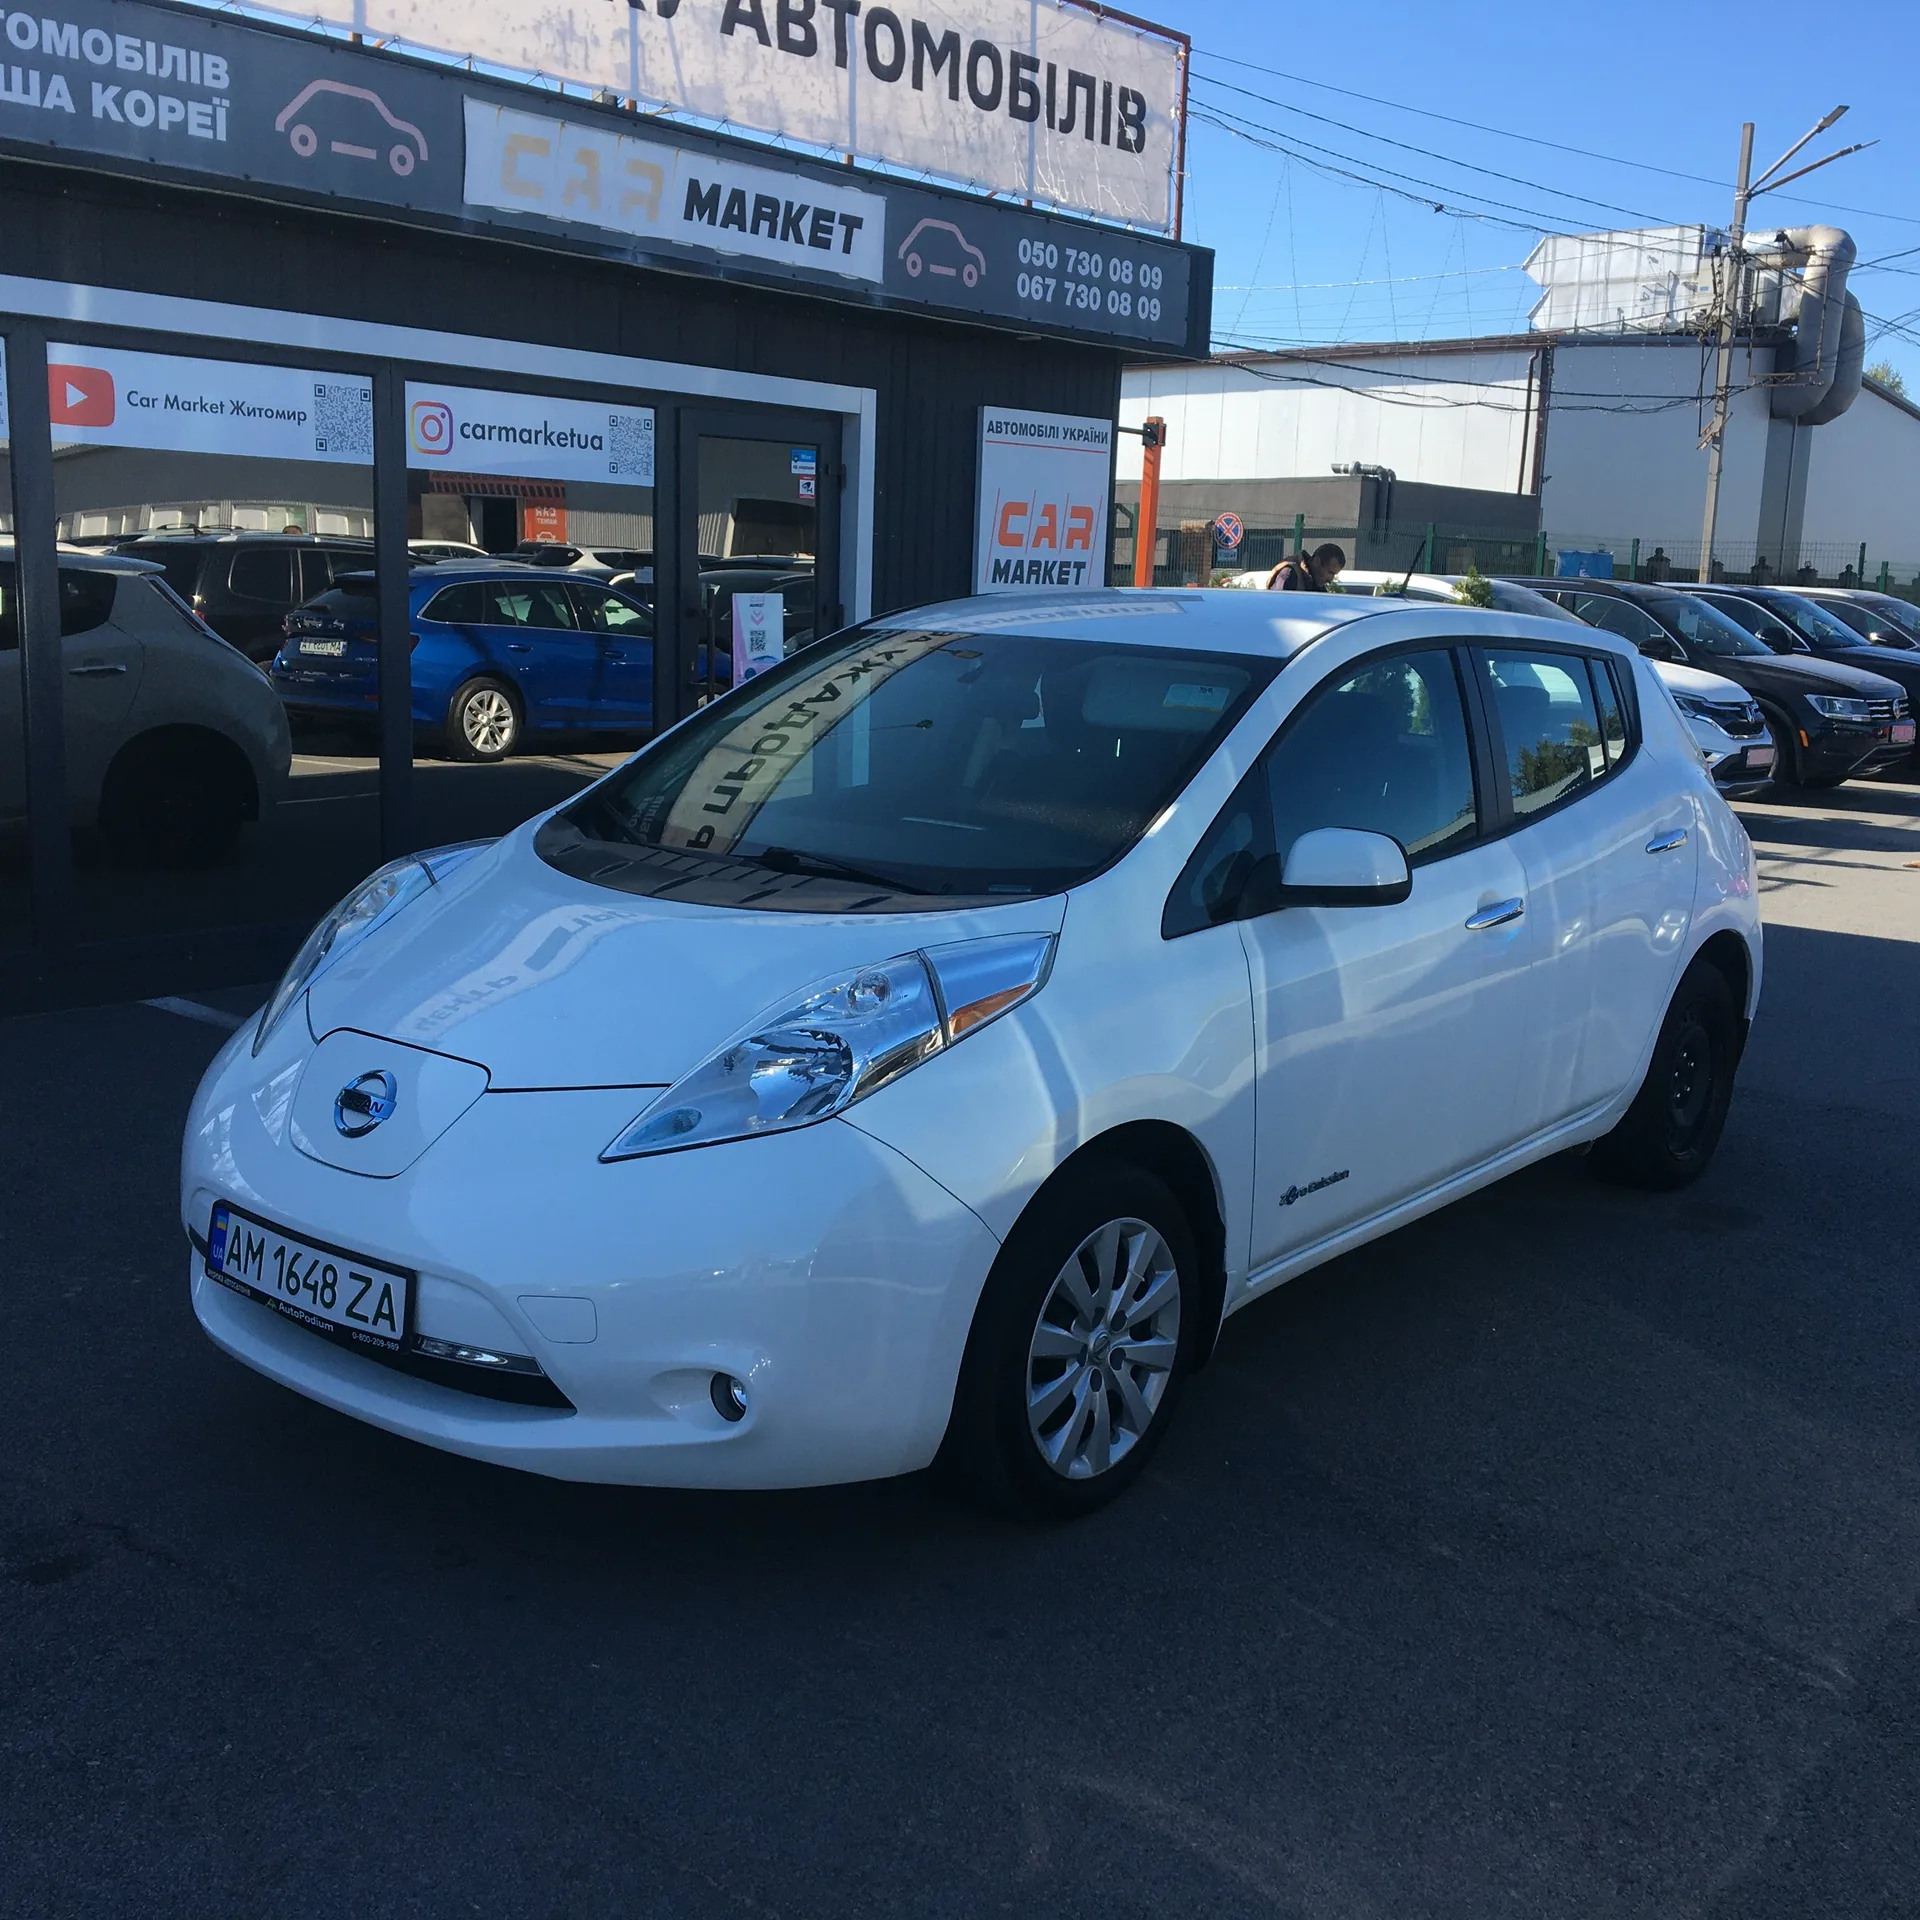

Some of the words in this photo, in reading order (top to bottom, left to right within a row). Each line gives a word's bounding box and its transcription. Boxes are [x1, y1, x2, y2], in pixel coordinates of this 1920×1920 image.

[0, 9, 229, 89] ОМОБІЛІВ
[720, 0, 1146, 154] АВТОМОБІЛІВ
[91, 81, 227, 142] КОРЕЇ
[683, 178, 864, 255] MARKET
[1018, 238, 1058, 269] 050
[1066, 247, 1102, 279] 730
[1109, 257, 1133, 285] 08
[1139, 263, 1163, 290] 09
[1016, 272, 1054, 303] 067
[1064, 281, 1101, 312] 730
[1107, 290, 1132, 319] 08
[1137, 297, 1161, 322] 09
[126, 390, 157, 409] Car
[164, 394, 225, 415] Market
[229, 399, 308, 426] Житомир
[986, 420, 1059, 439] АВТОМОБІЛІ
[1062, 425, 1108, 445] УКРАЇНИ
[460, 420, 603, 451] carmarketua
[997, 501, 1094, 550] CAR
[991, 558, 1086, 585] MARKET
[212, 1244, 223, 1261] UA
[226, 1225, 265, 1281] AM
[273, 1245, 338, 1310] 1648
[345, 1271, 396, 1333] ZA
[279, 1302, 334, 1332] AutoPodium
[352, 1331, 399, 1351] 0-800-209-989
